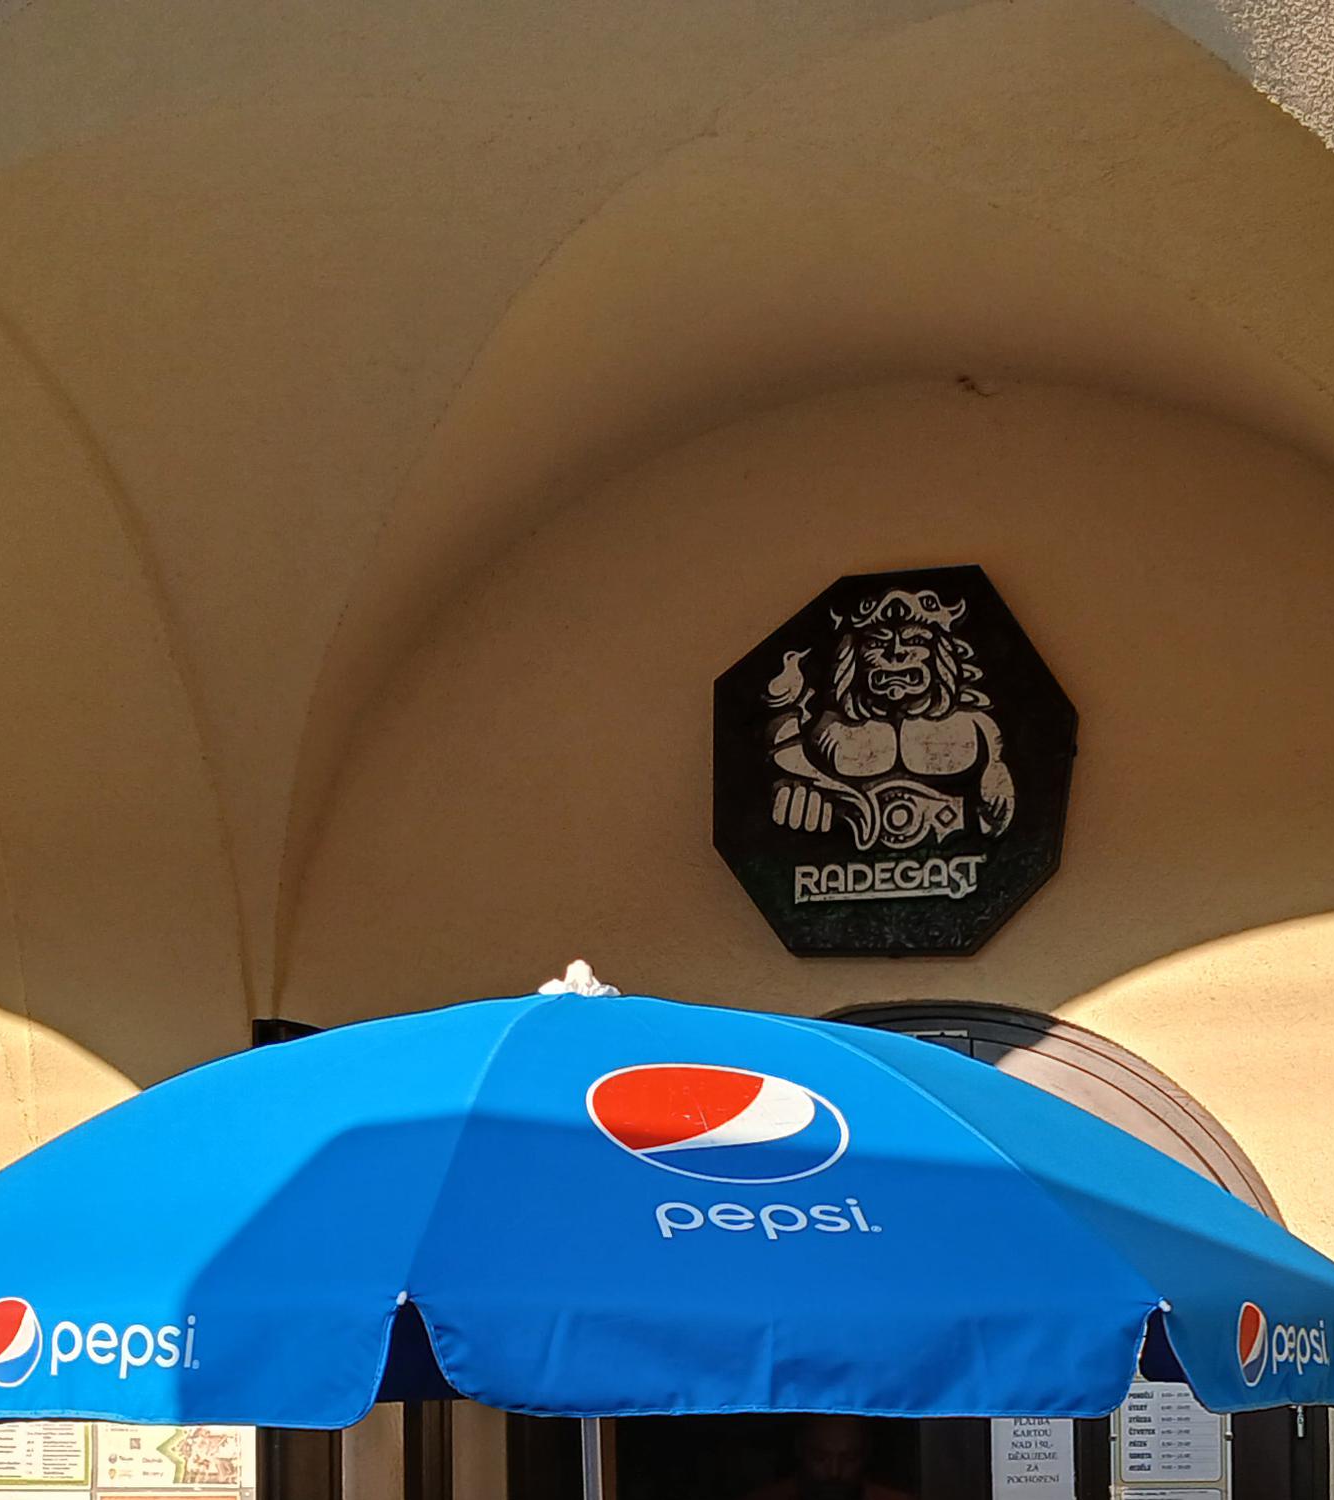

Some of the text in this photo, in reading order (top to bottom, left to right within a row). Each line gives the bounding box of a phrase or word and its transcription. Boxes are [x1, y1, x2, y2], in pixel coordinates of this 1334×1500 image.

[794, 853, 987, 905] RADEGAST
[654, 1197, 871, 1241] pepsi
[50, 1314, 196, 1380] pepsi
[1272, 1319, 1329, 1375] pepsi
[1011, 1440, 1033, 1449] NAD
[1012, 1429, 1052, 1437] KARTOU
[1026, 1464, 1039, 1472] ZA
